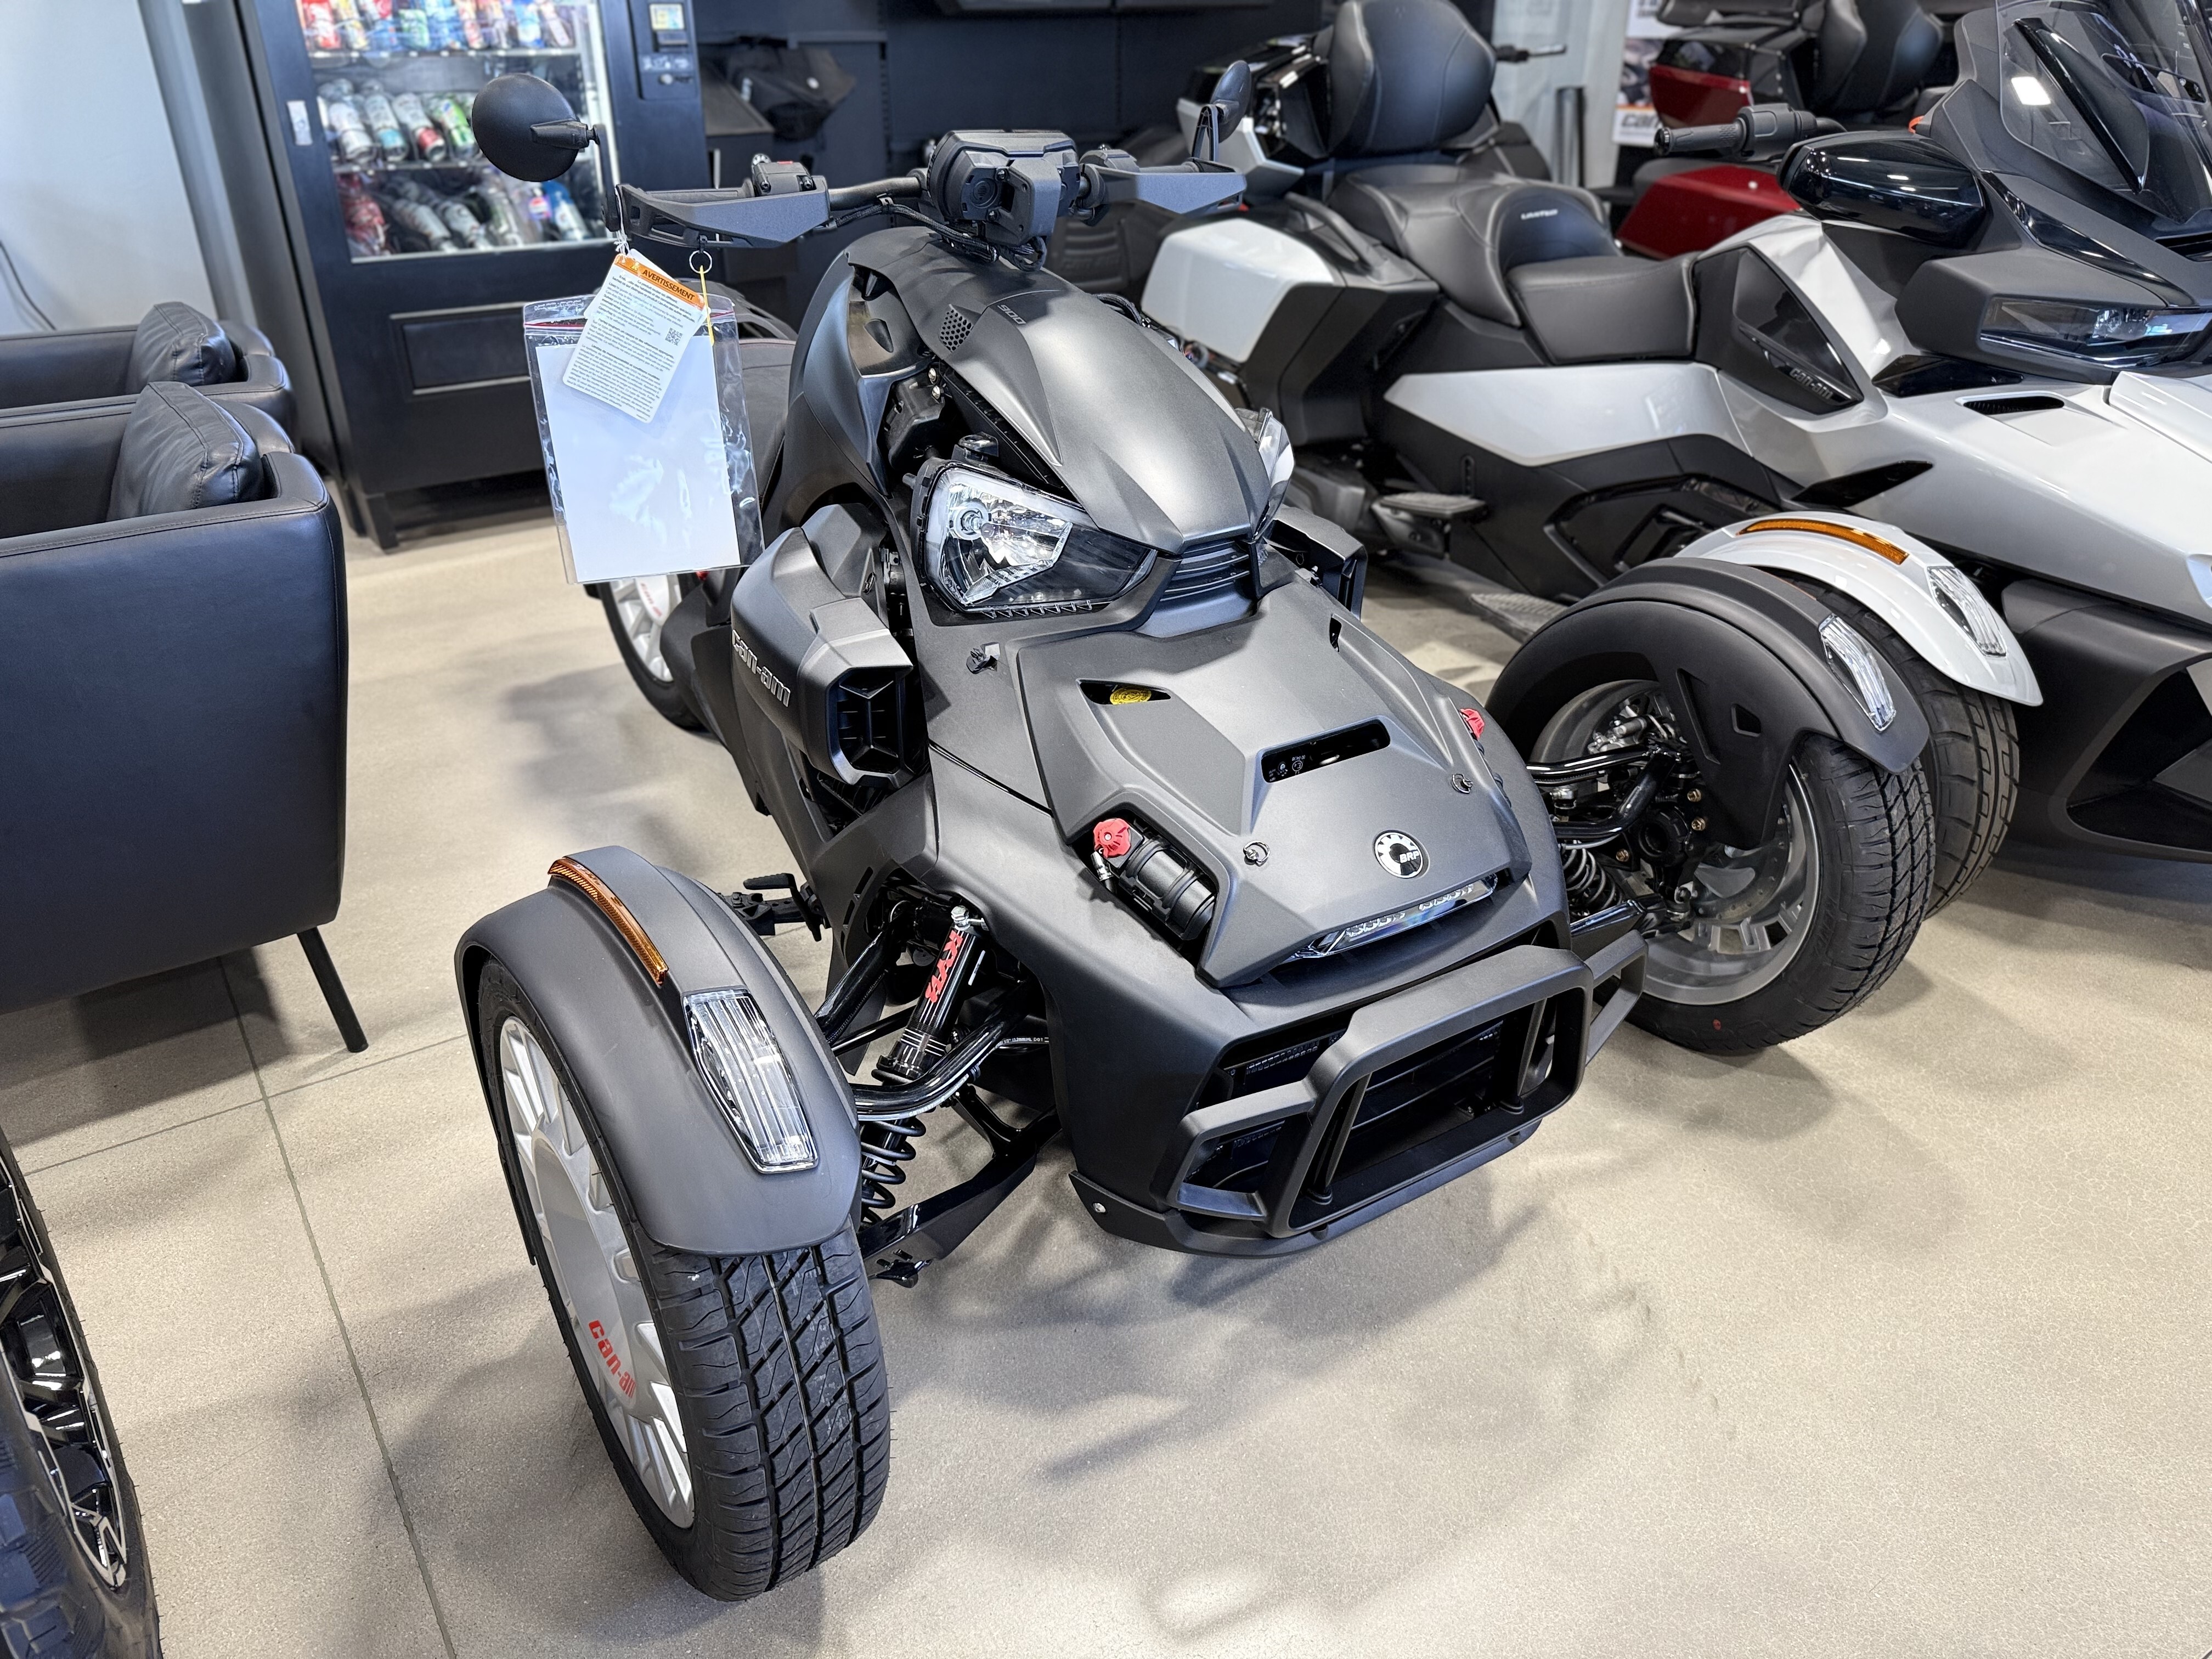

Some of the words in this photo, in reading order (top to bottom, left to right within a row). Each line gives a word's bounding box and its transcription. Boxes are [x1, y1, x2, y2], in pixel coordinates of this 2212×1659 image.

[642, 269, 695, 301] AVERTISSEMENT
[997, 304, 1026, 324] 900
[1789, 368, 1833, 399] can-am
[732, 629, 791, 707] can-am
[1400, 850, 1420, 864] BRP
[925, 930, 963, 1003] KYB
[589, 1320, 637, 1398] can-am
